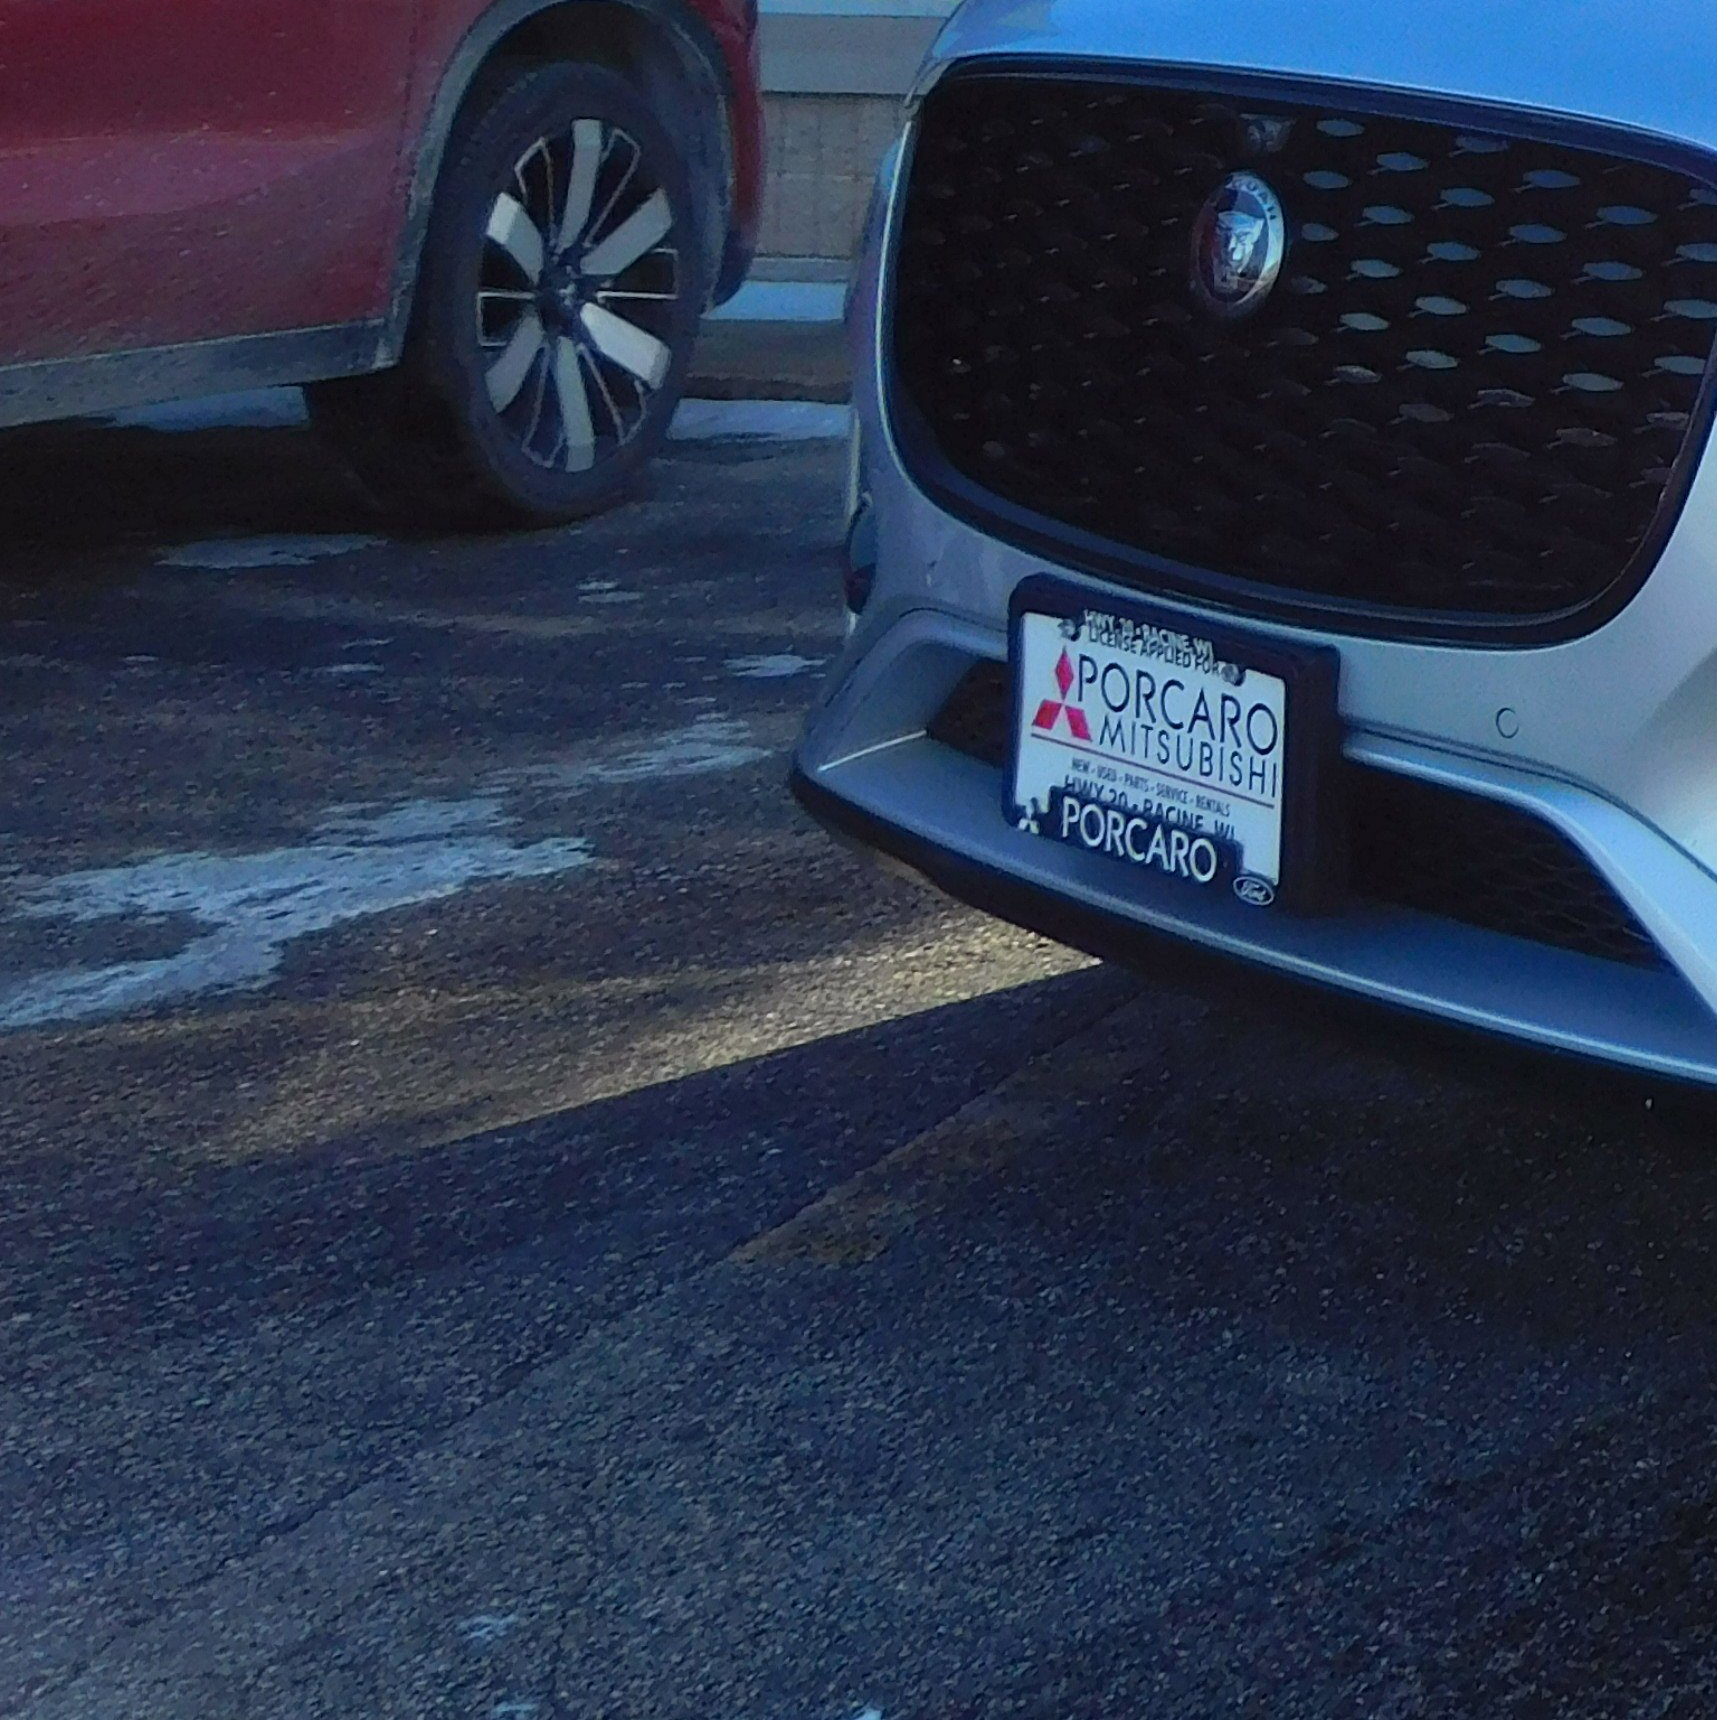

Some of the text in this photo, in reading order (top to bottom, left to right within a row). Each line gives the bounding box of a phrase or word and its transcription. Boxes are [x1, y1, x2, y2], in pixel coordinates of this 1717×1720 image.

[1076, 652, 1279, 757] PORCARO
[1100, 714, 1279, 799] MITSUBISHI
[1155, 781, 1189, 804] SERVICE
[1195, 793, 1231, 818] RENTALS
[1061, 795, 1217, 882] PORCARO
